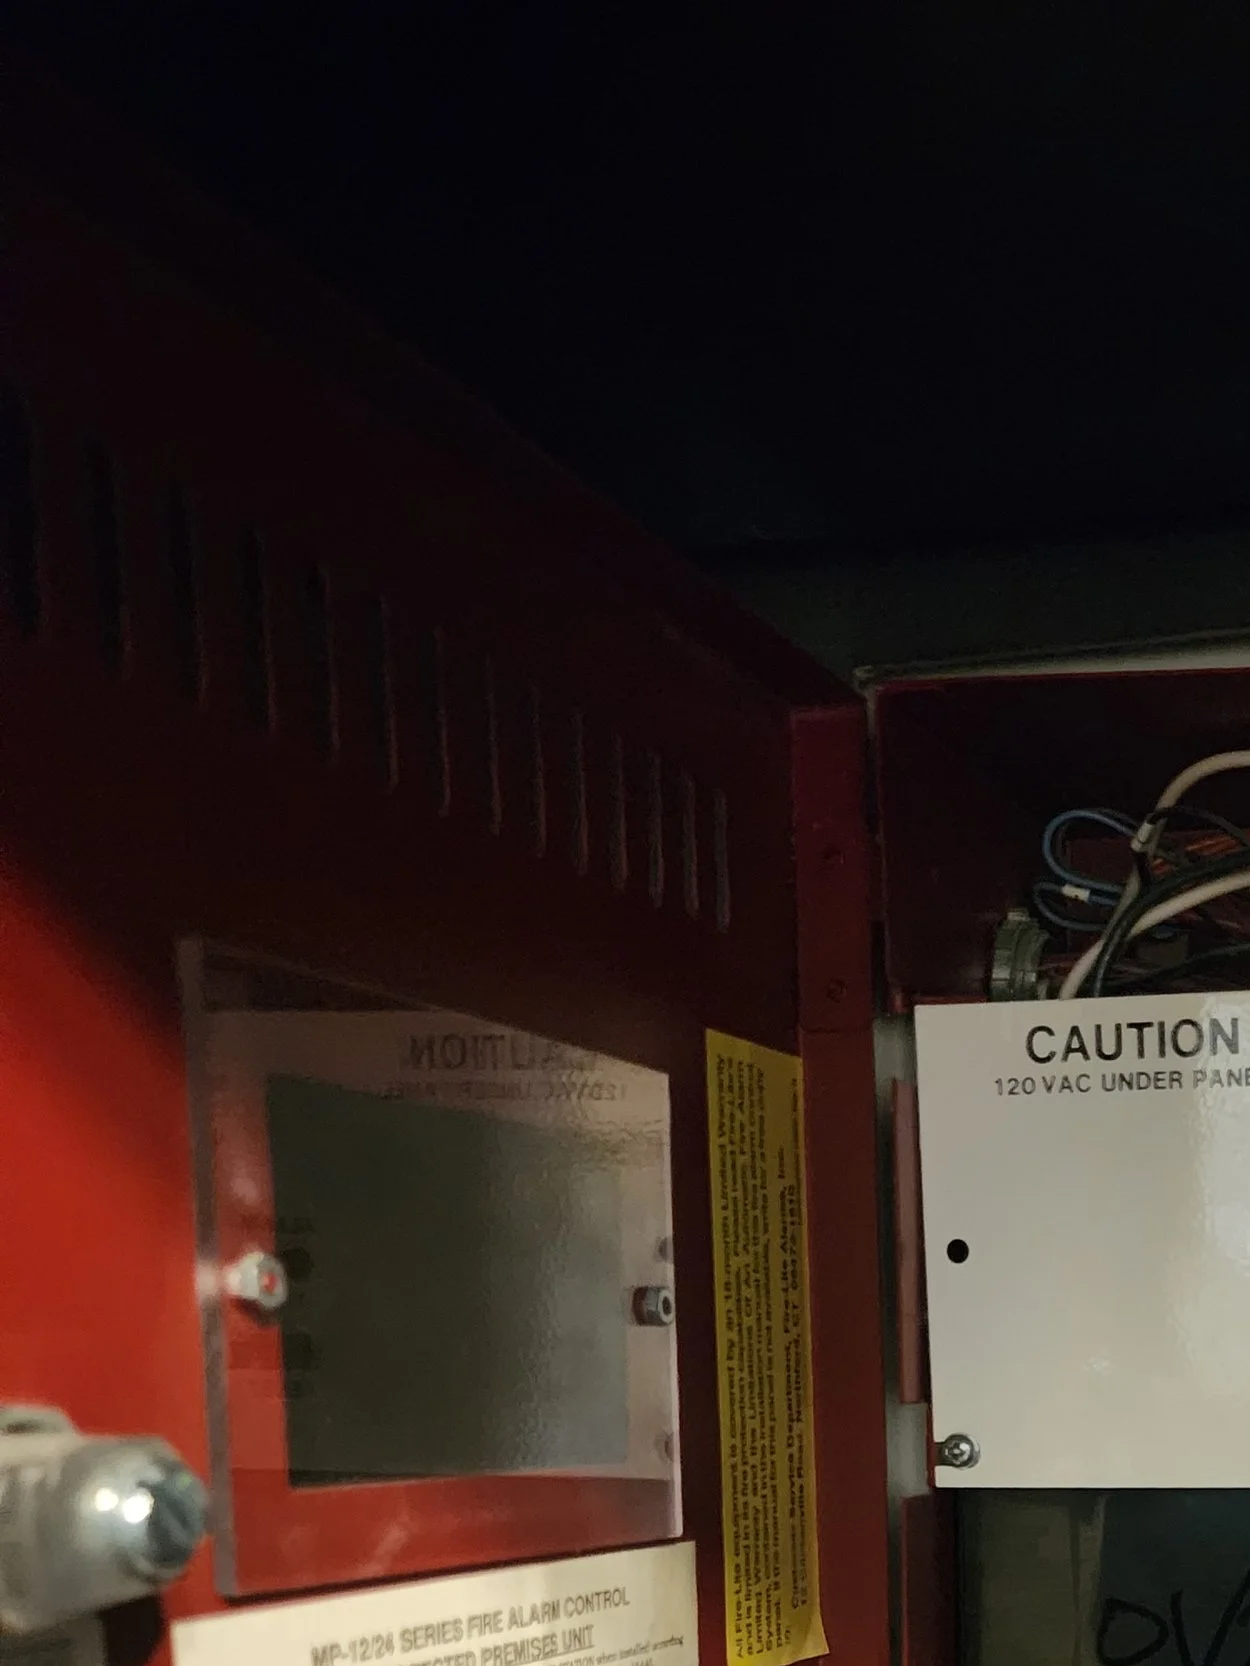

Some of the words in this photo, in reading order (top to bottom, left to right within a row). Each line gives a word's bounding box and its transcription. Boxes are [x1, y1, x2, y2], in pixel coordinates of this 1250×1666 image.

[1025, 1017, 1240, 1064] CAUTION
[995, 1075, 1036, 1096] 120
[1043, 1073, 1092, 1094] VAC
[1101, 1071, 1183, 1092] UNDER
[400, 1620, 464, 1652] SERIES
[467, 1613, 504, 1638] FIRE
[508, 1602, 560, 1629] ALARM
[564, 1588, 630, 1617] CONTROL
[563, 1626, 594, 1650] UNIT
